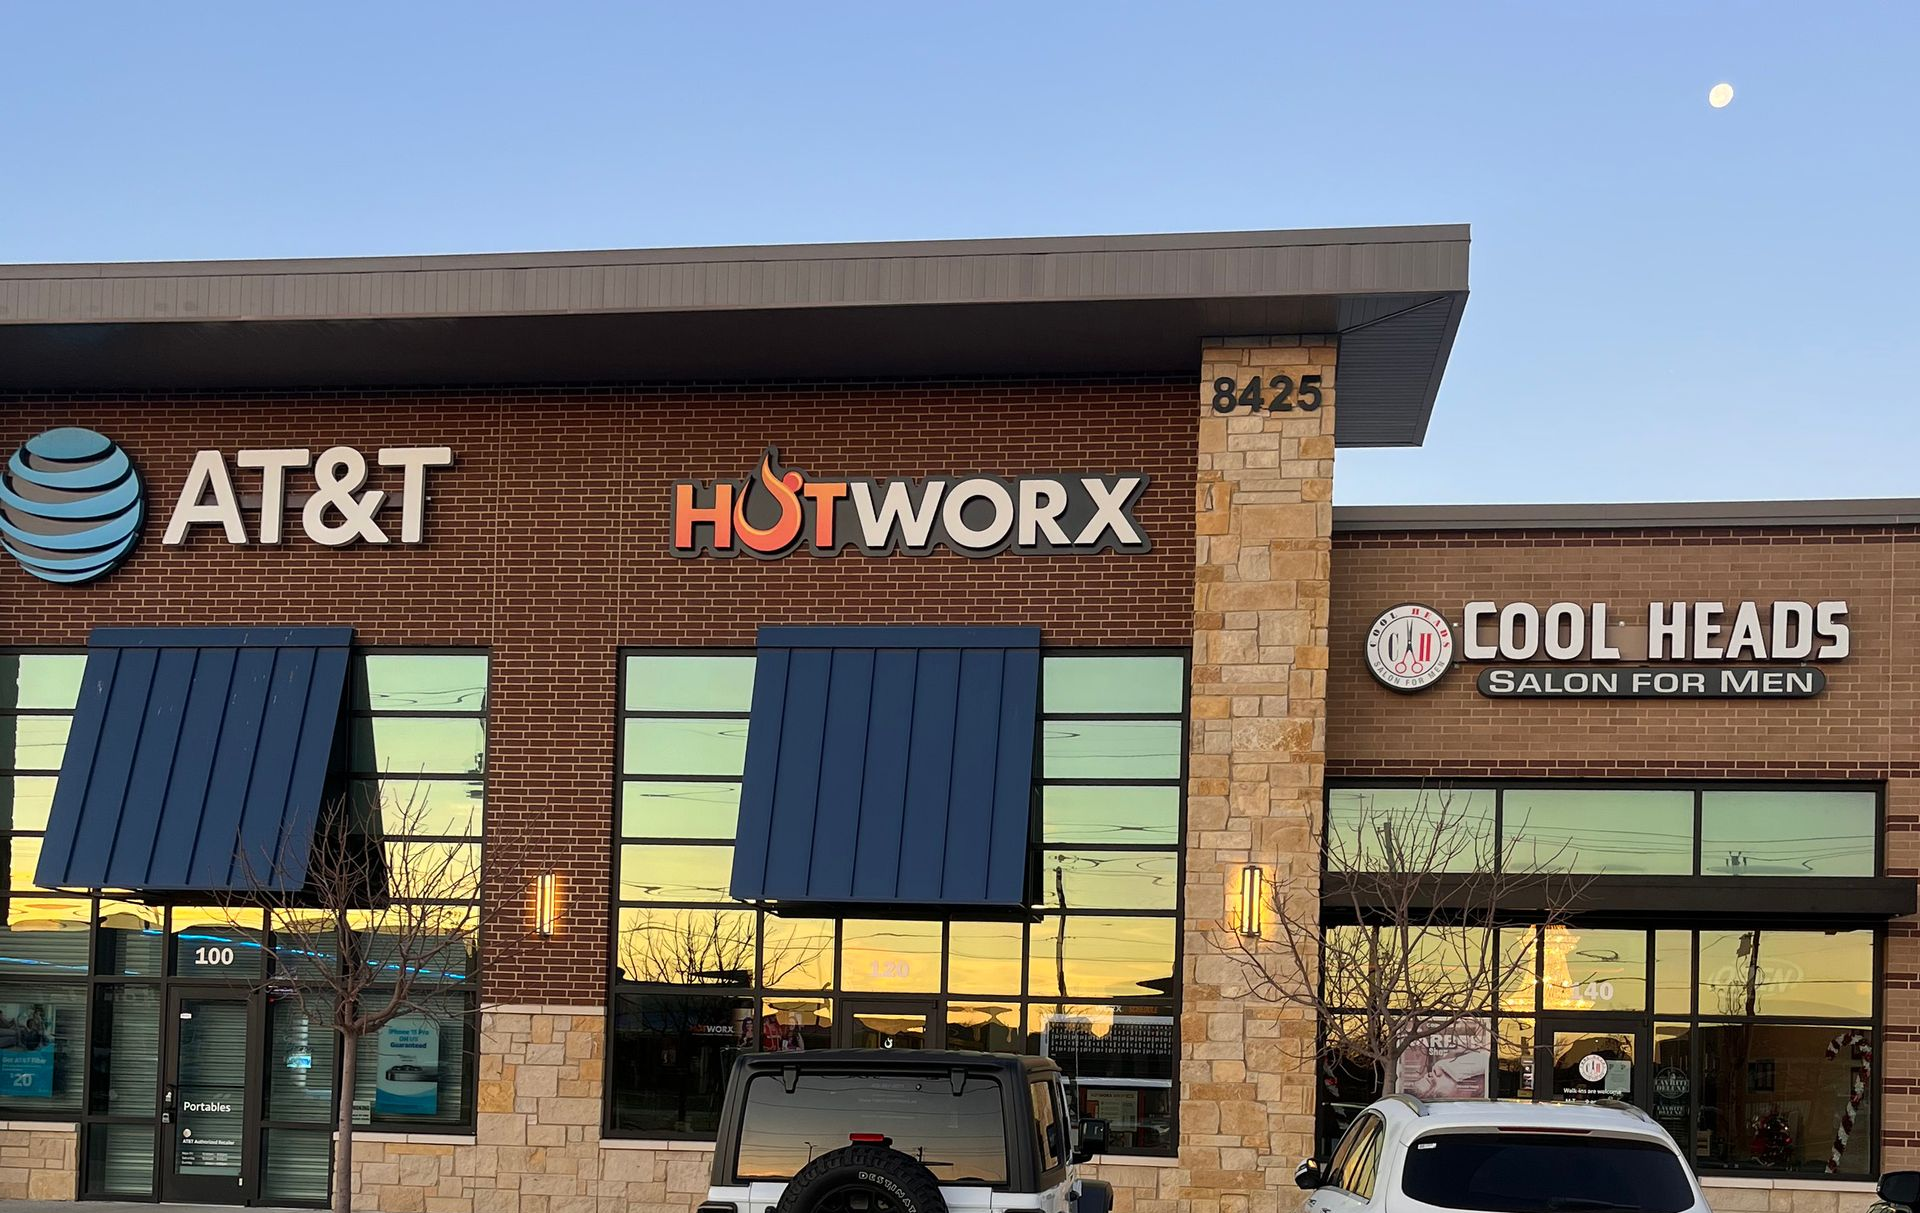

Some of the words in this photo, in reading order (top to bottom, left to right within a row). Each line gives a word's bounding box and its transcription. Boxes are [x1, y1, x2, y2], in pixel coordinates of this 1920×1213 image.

[1212, 374, 1322, 413] 8425
[161, 446, 452, 545] AT&T
[674, 450, 1142, 552] HOTWORX
[1370, 612, 1397, 648] COOL
[1411, 608, 1450, 648] HEADS
[1463, 601, 1620, 660] COOL
[1648, 600, 1850, 660] HEADS
[1373, 661, 1401, 685] SALON
[1405, 677, 1425, 686] FOR
[1428, 660, 1445, 679] MEN
[1489, 669, 1618, 693] SALON
[1632, 672, 1706, 693] FOR
[1720, 670, 1813, 693] MEN
[195, 947, 234, 965] 100
[871, 959, 909, 977] 120
[1571, 981, 1614, 1001] 140
[183, 1101, 232, 1112] Portables
